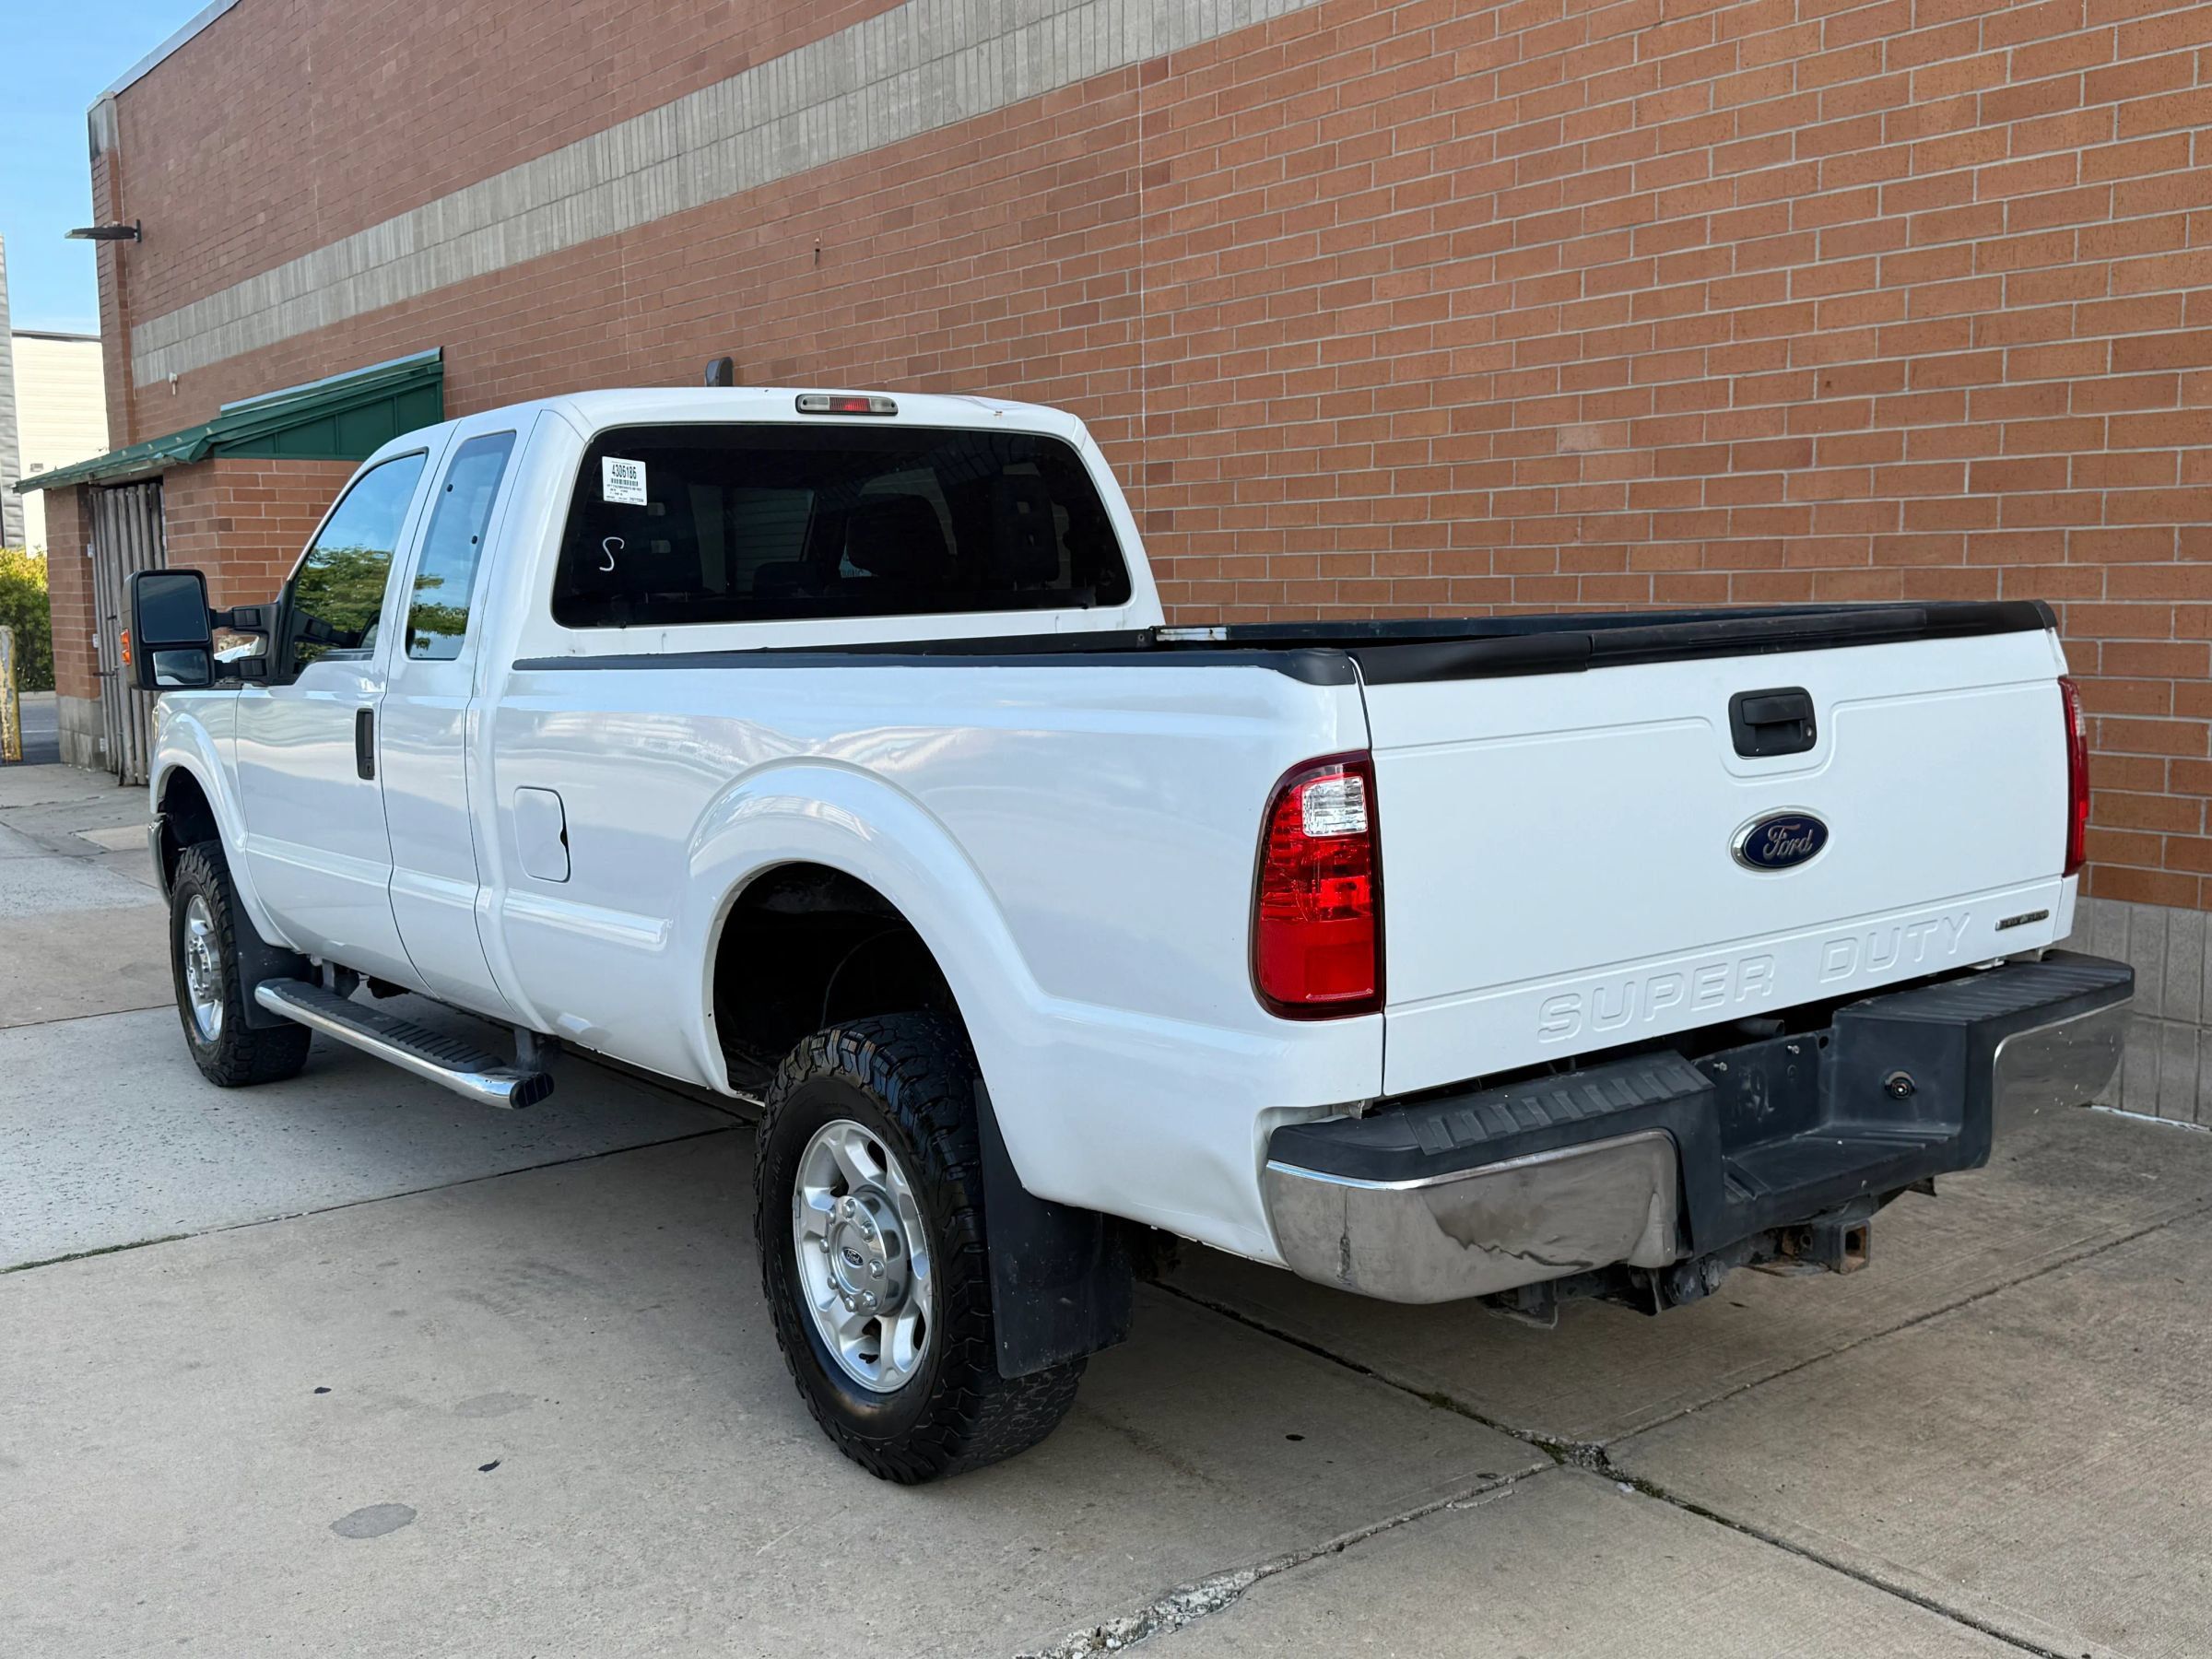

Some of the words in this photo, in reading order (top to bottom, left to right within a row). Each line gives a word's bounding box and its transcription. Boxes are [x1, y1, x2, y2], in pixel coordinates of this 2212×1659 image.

[1763, 824, 1813, 861] Ford
[1536, 952, 1775, 1044] SUPER
[1819, 912, 1971, 984] DUTY
